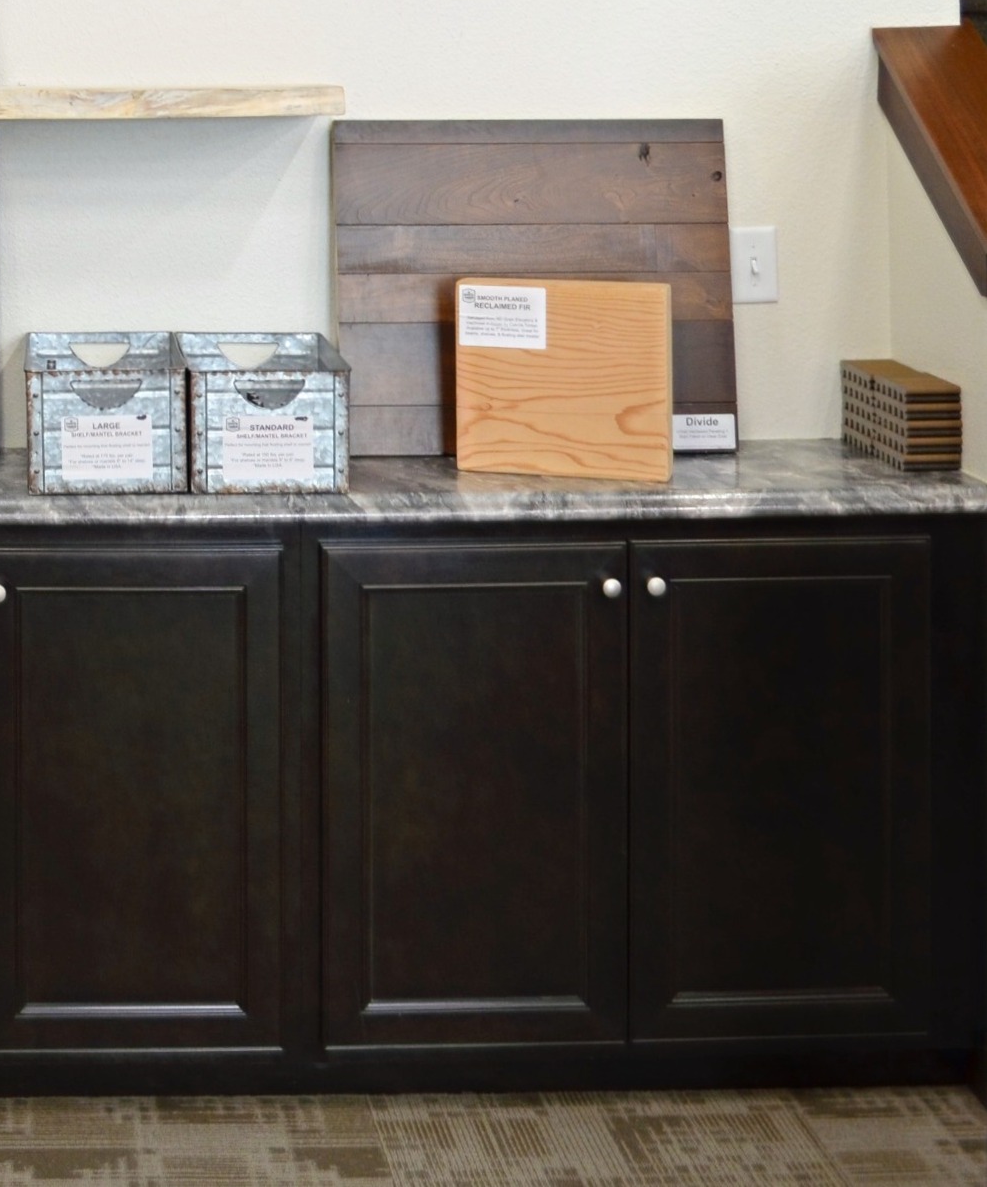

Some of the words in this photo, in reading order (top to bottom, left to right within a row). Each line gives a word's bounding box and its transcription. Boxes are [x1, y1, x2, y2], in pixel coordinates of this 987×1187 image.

[474, 302, 518, 311] RECLAIMED
[92, 422, 121, 430] LARGE
[685, 416, 720, 427] Divide
[249, 423, 295, 432] STANDARD
[281, 432, 308, 440] BRACKET
